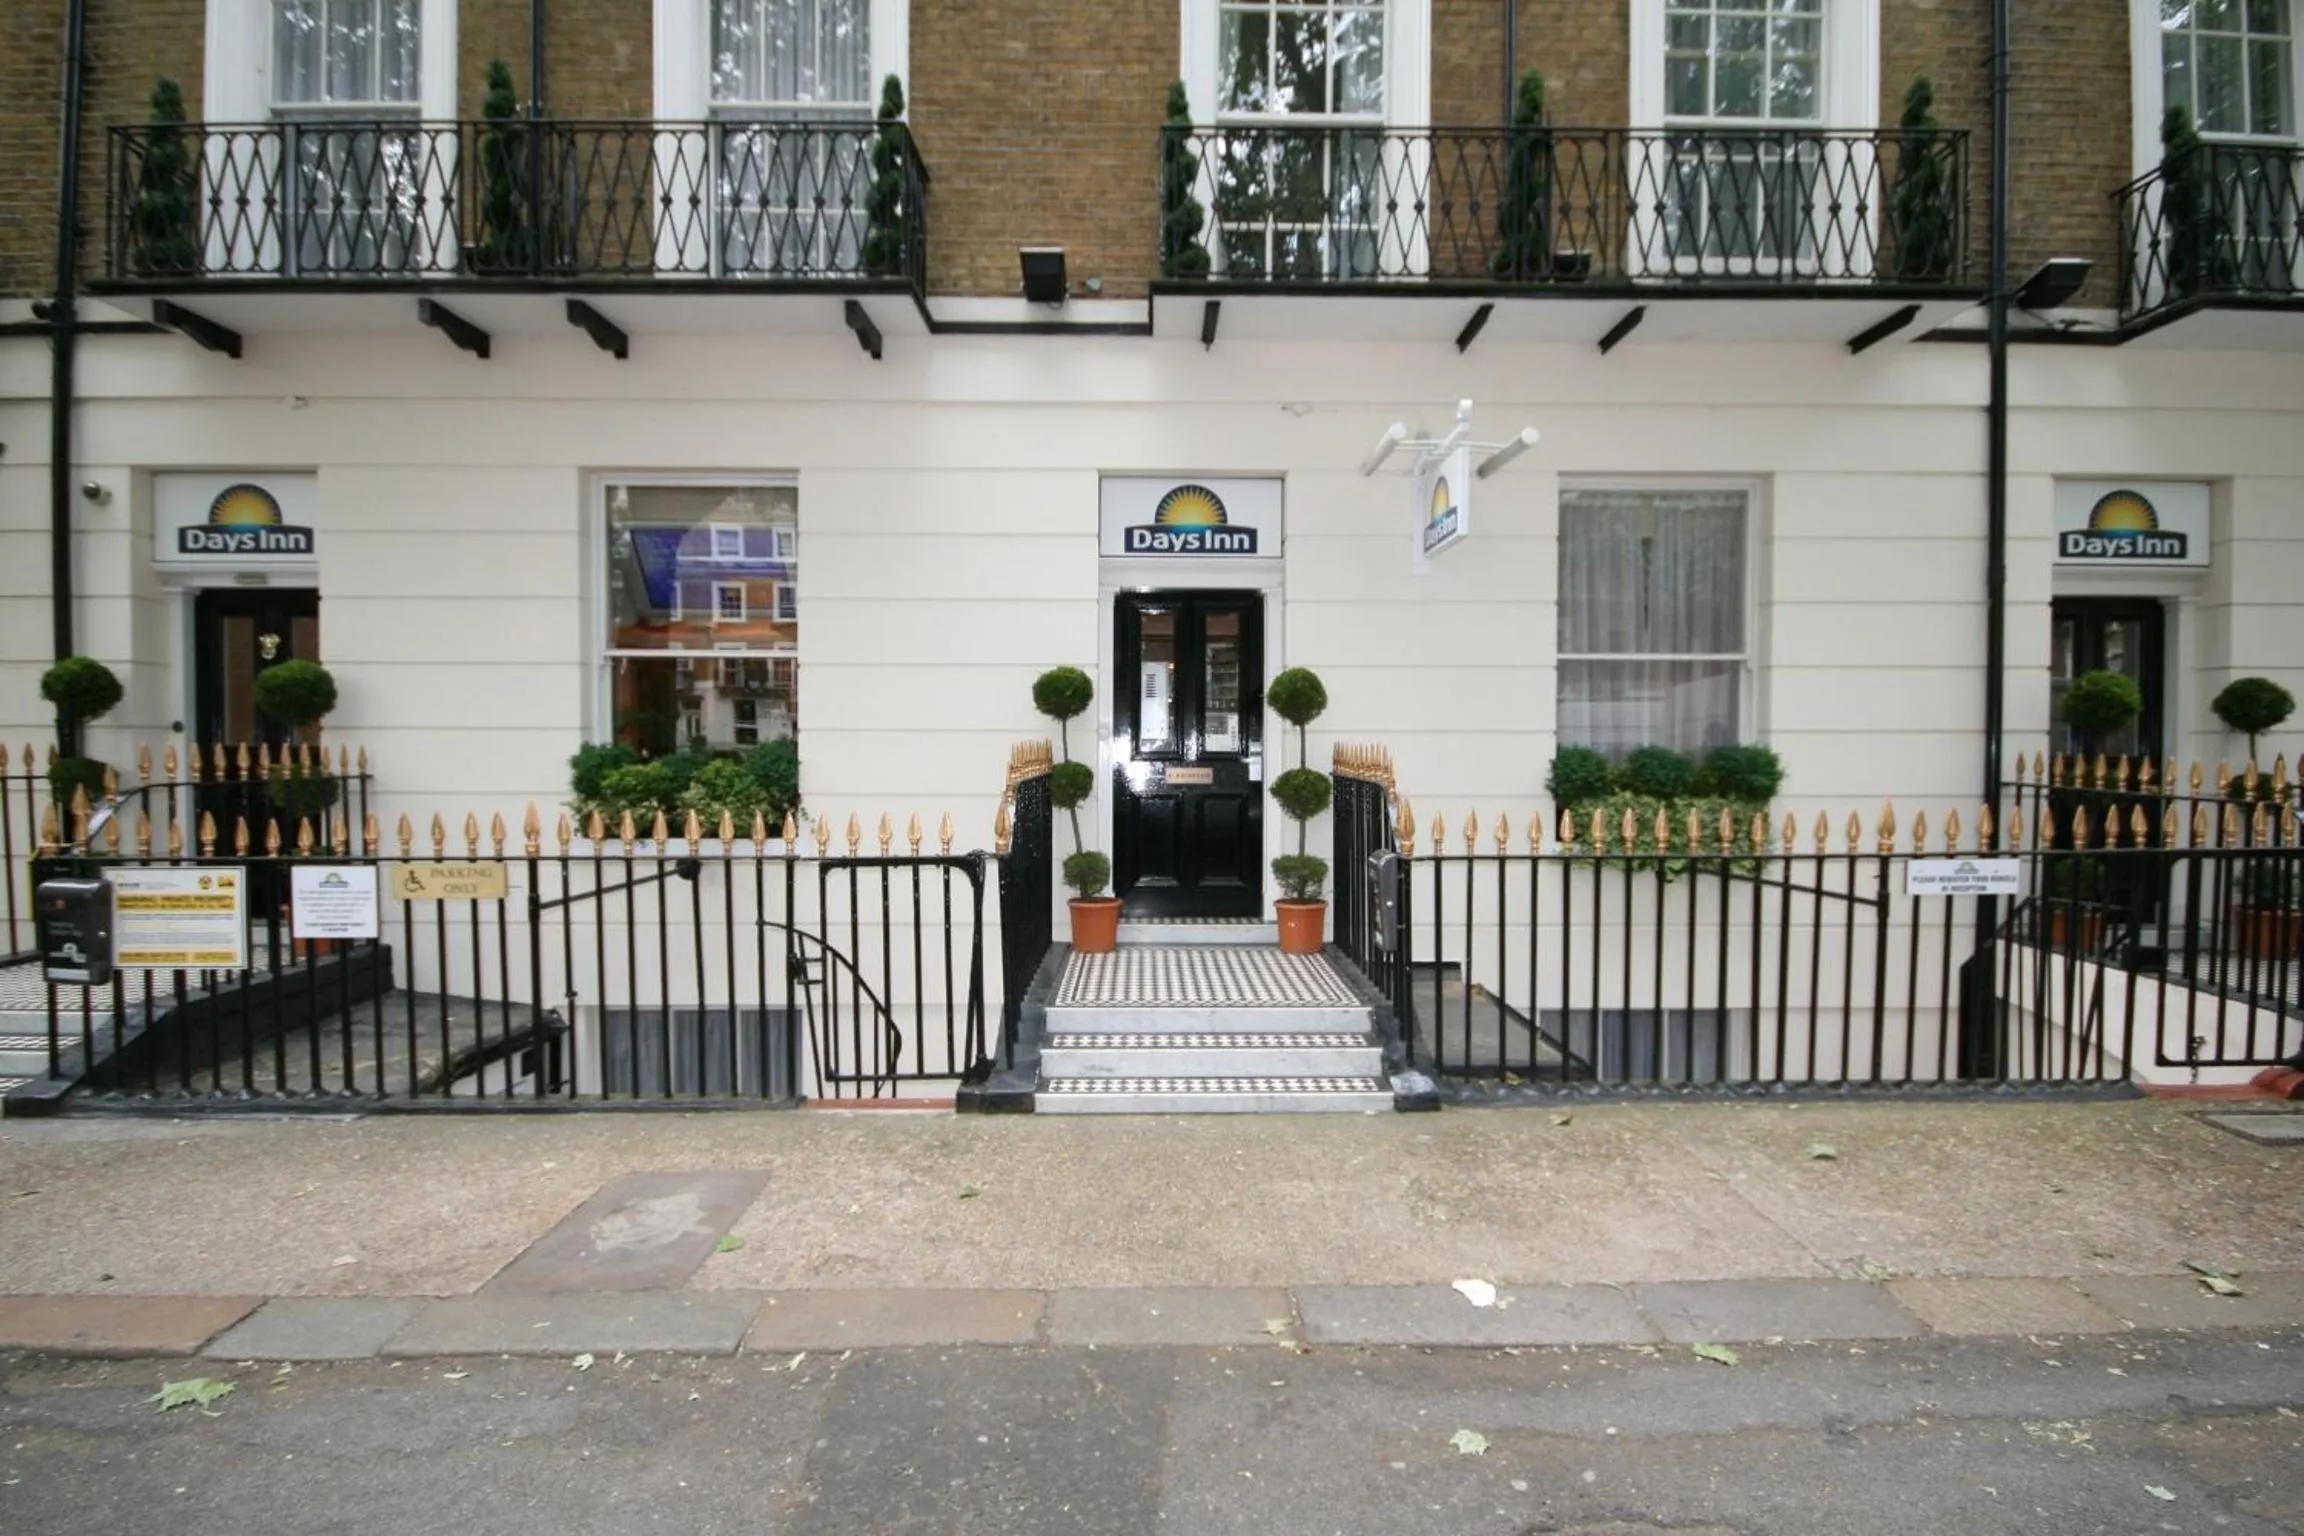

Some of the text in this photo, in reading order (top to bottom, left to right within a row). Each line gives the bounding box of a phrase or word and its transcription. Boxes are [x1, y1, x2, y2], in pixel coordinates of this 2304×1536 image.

[186, 529, 307, 552] Days Inn
[1132, 529, 1250, 552] Days Inn
[2066, 534, 2181, 556] Days Inn
[430, 867, 492, 878] PARKING
[443, 883, 478, 893] ONLY
